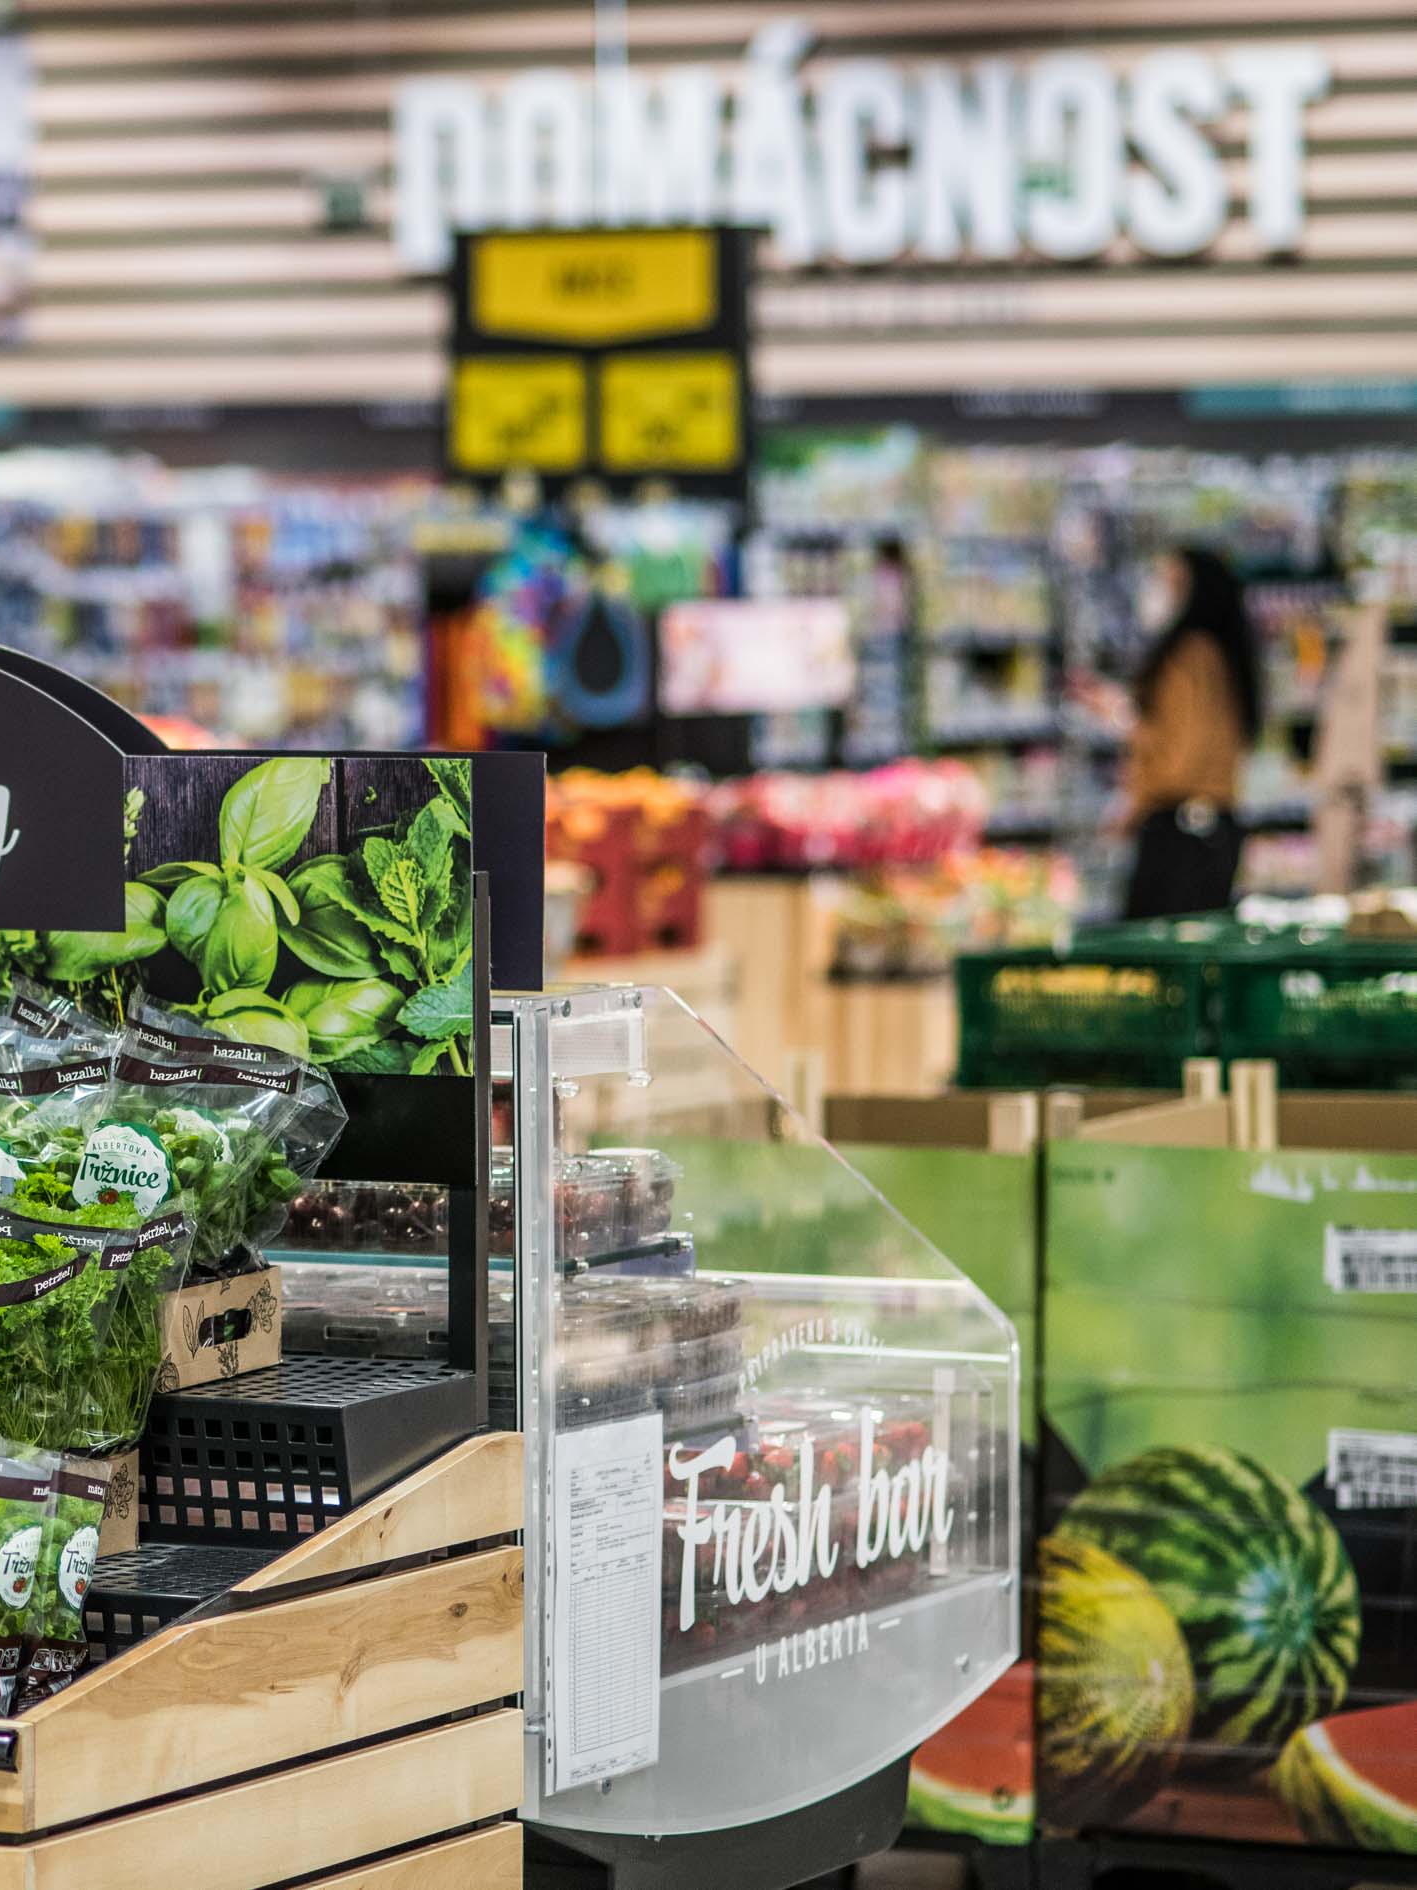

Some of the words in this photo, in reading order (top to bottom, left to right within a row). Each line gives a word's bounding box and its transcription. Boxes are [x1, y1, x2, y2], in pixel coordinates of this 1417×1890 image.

[138, 1028, 173, 1052] bazalka
[213, 1045, 263, 1062] bazalka
[57, 1066, 102, 1085] bazalka
[149, 1068, 198, 1082] bazalka
[236, 1071, 287, 1092] bazalka
[92, 1141, 147, 1158] ALBERTOVA
[79, 1152, 161, 1189] Tržnice
[138, 1221, 170, 1247] petržel
[34, 1267, 72, 1297] petržel
[668, 1436, 840, 1633] Fresh
[855, 1404, 955, 1569] bar
[753, 1643, 768, 1687] U
[778, 1611, 870, 1681] ALBERTA
